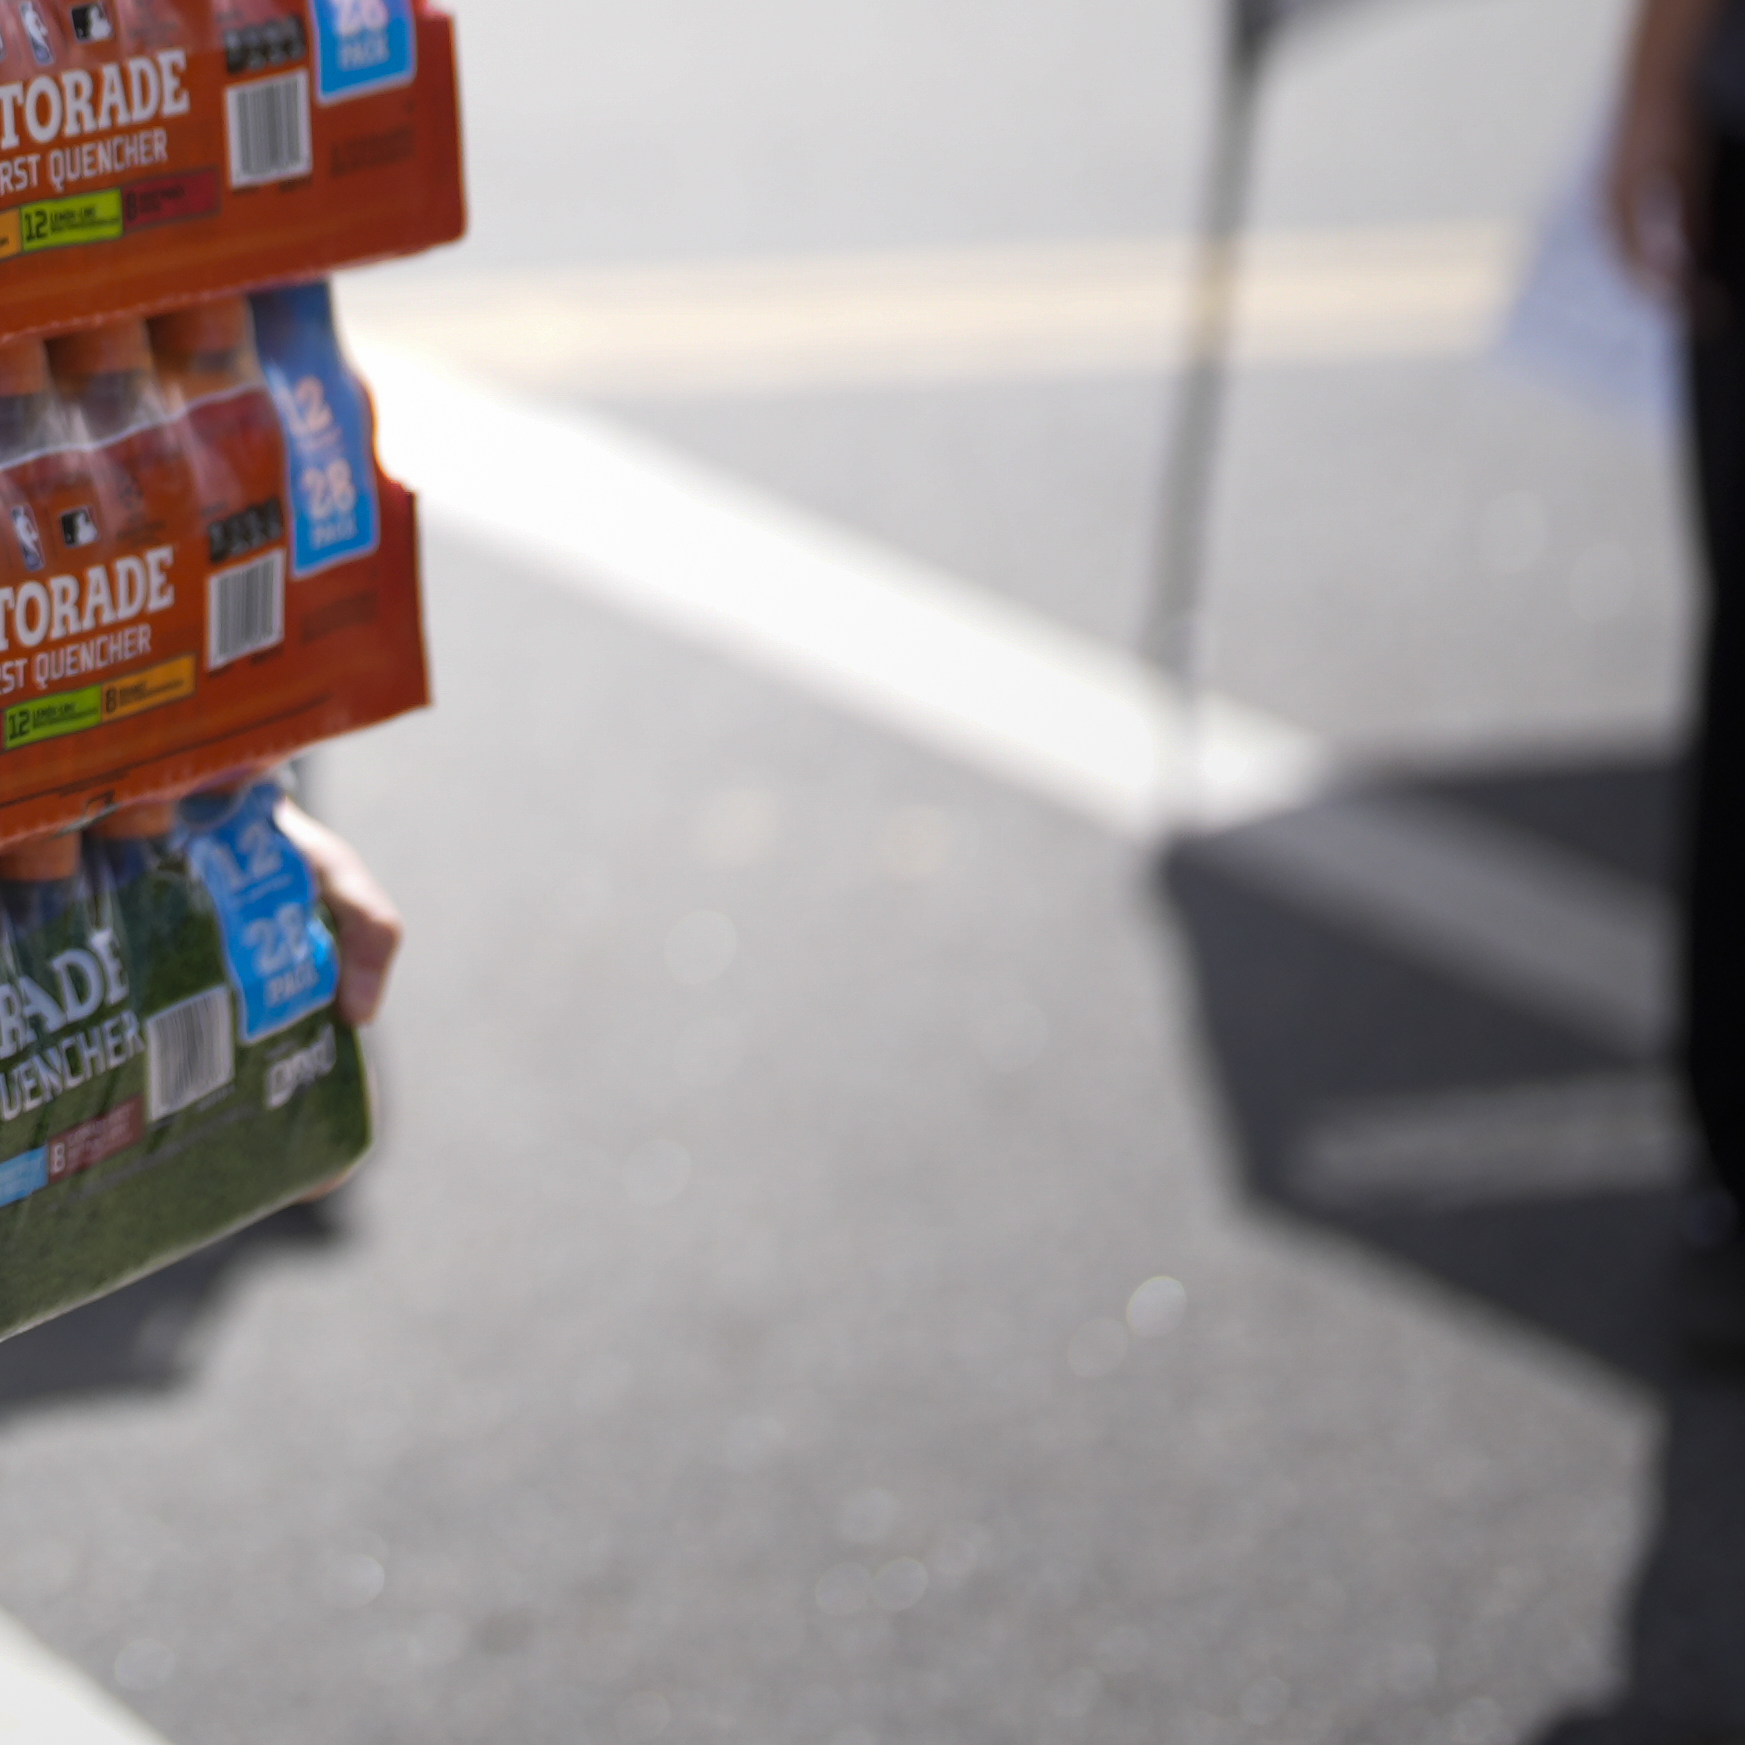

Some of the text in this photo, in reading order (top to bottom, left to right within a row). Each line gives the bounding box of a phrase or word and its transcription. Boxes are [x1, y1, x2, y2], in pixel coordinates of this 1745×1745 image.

[48, 127, 168, 193] QUENCHER
[24, 210, 48, 242] 12
[300, 459, 356, 522] 28
[32, 622, 152, 691] QUENCHER
[7, 708, 30, 741] 12
[238, 902, 310, 978] 28
[49, 1142, 65, 1174] 8
